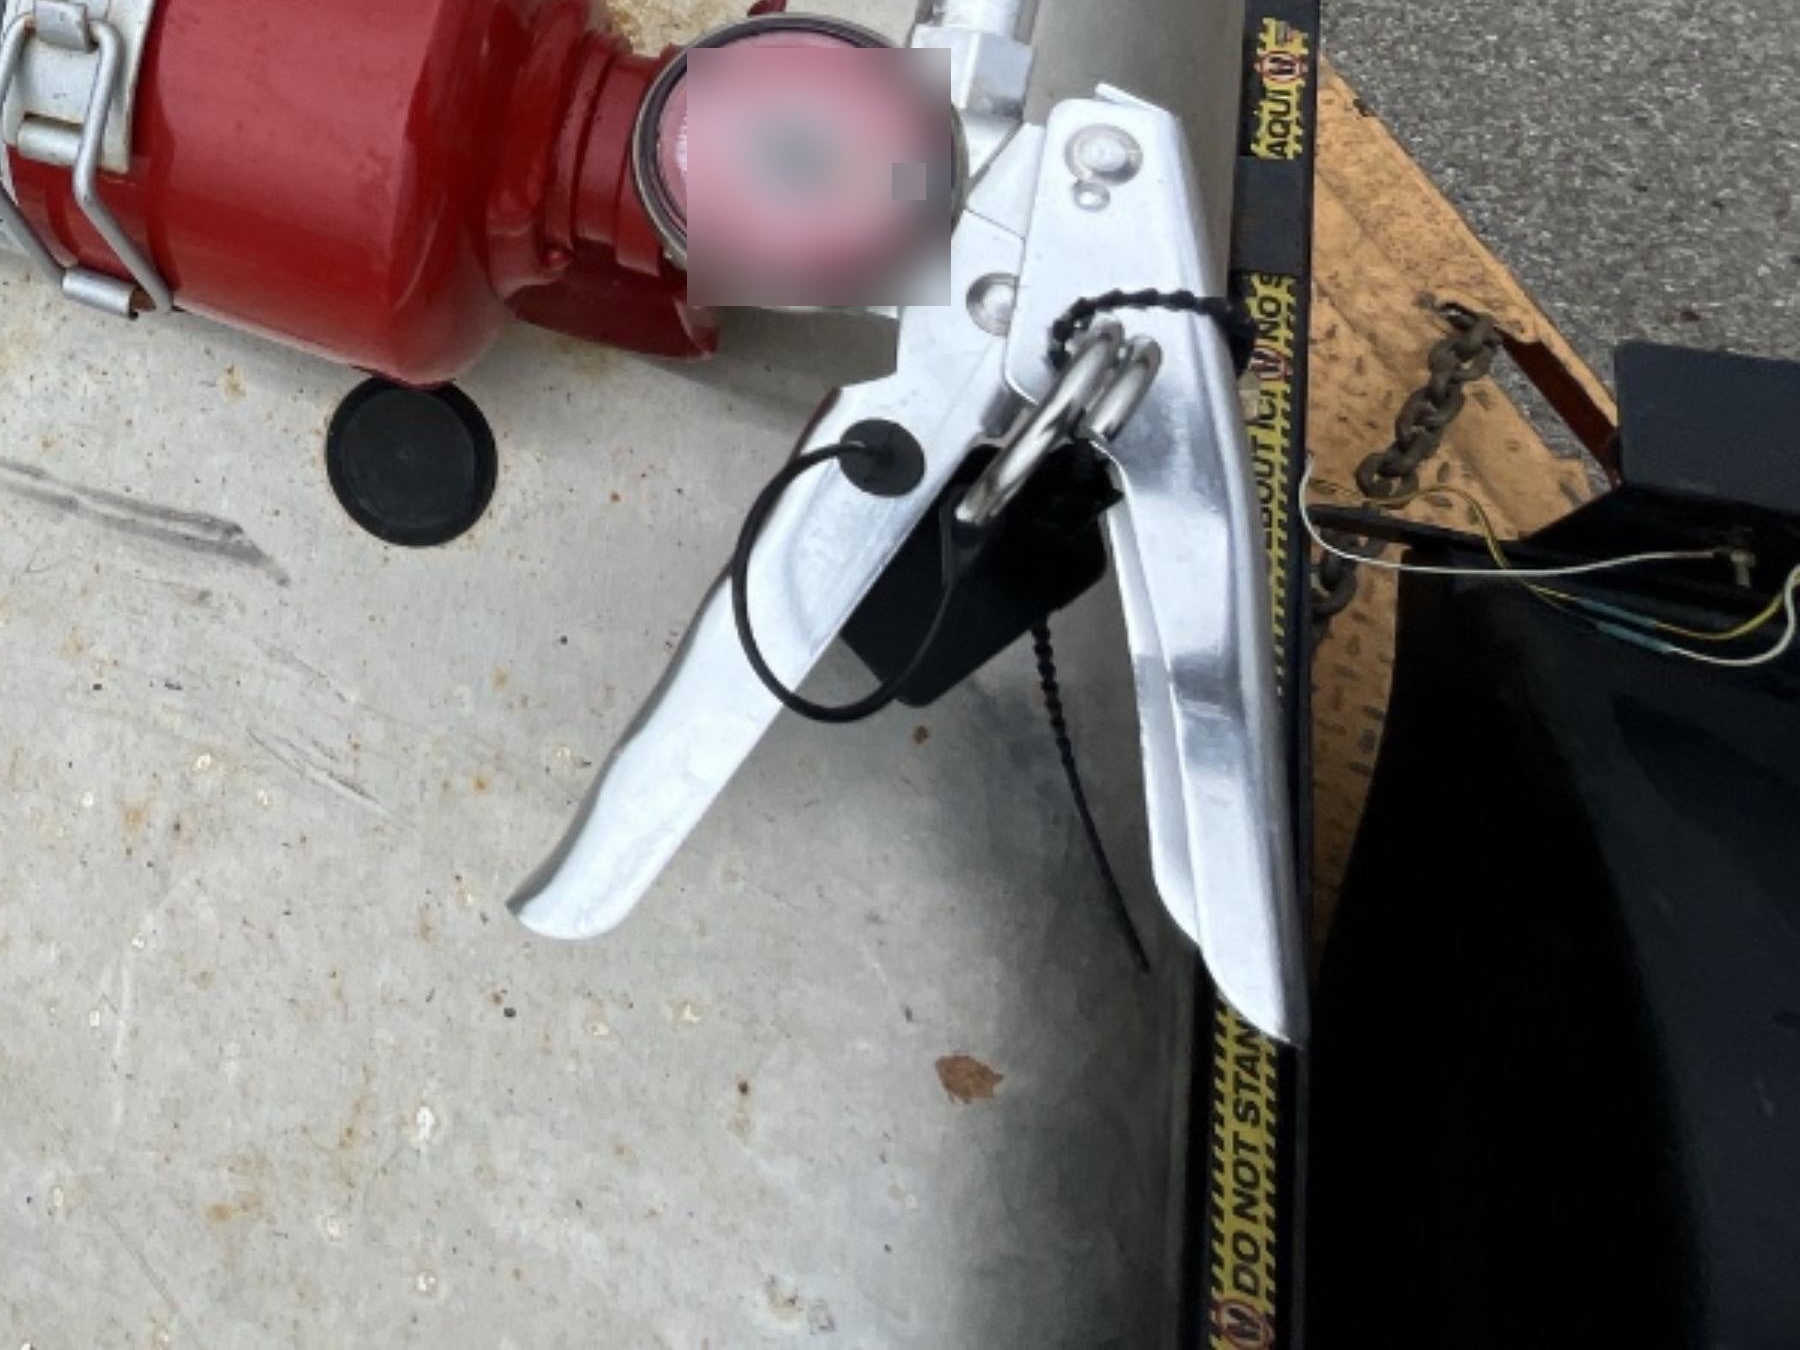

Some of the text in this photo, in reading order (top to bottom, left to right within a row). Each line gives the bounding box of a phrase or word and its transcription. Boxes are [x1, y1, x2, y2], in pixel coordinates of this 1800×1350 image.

[1231, 1020, 1262, 1298] DO NOT STAN
